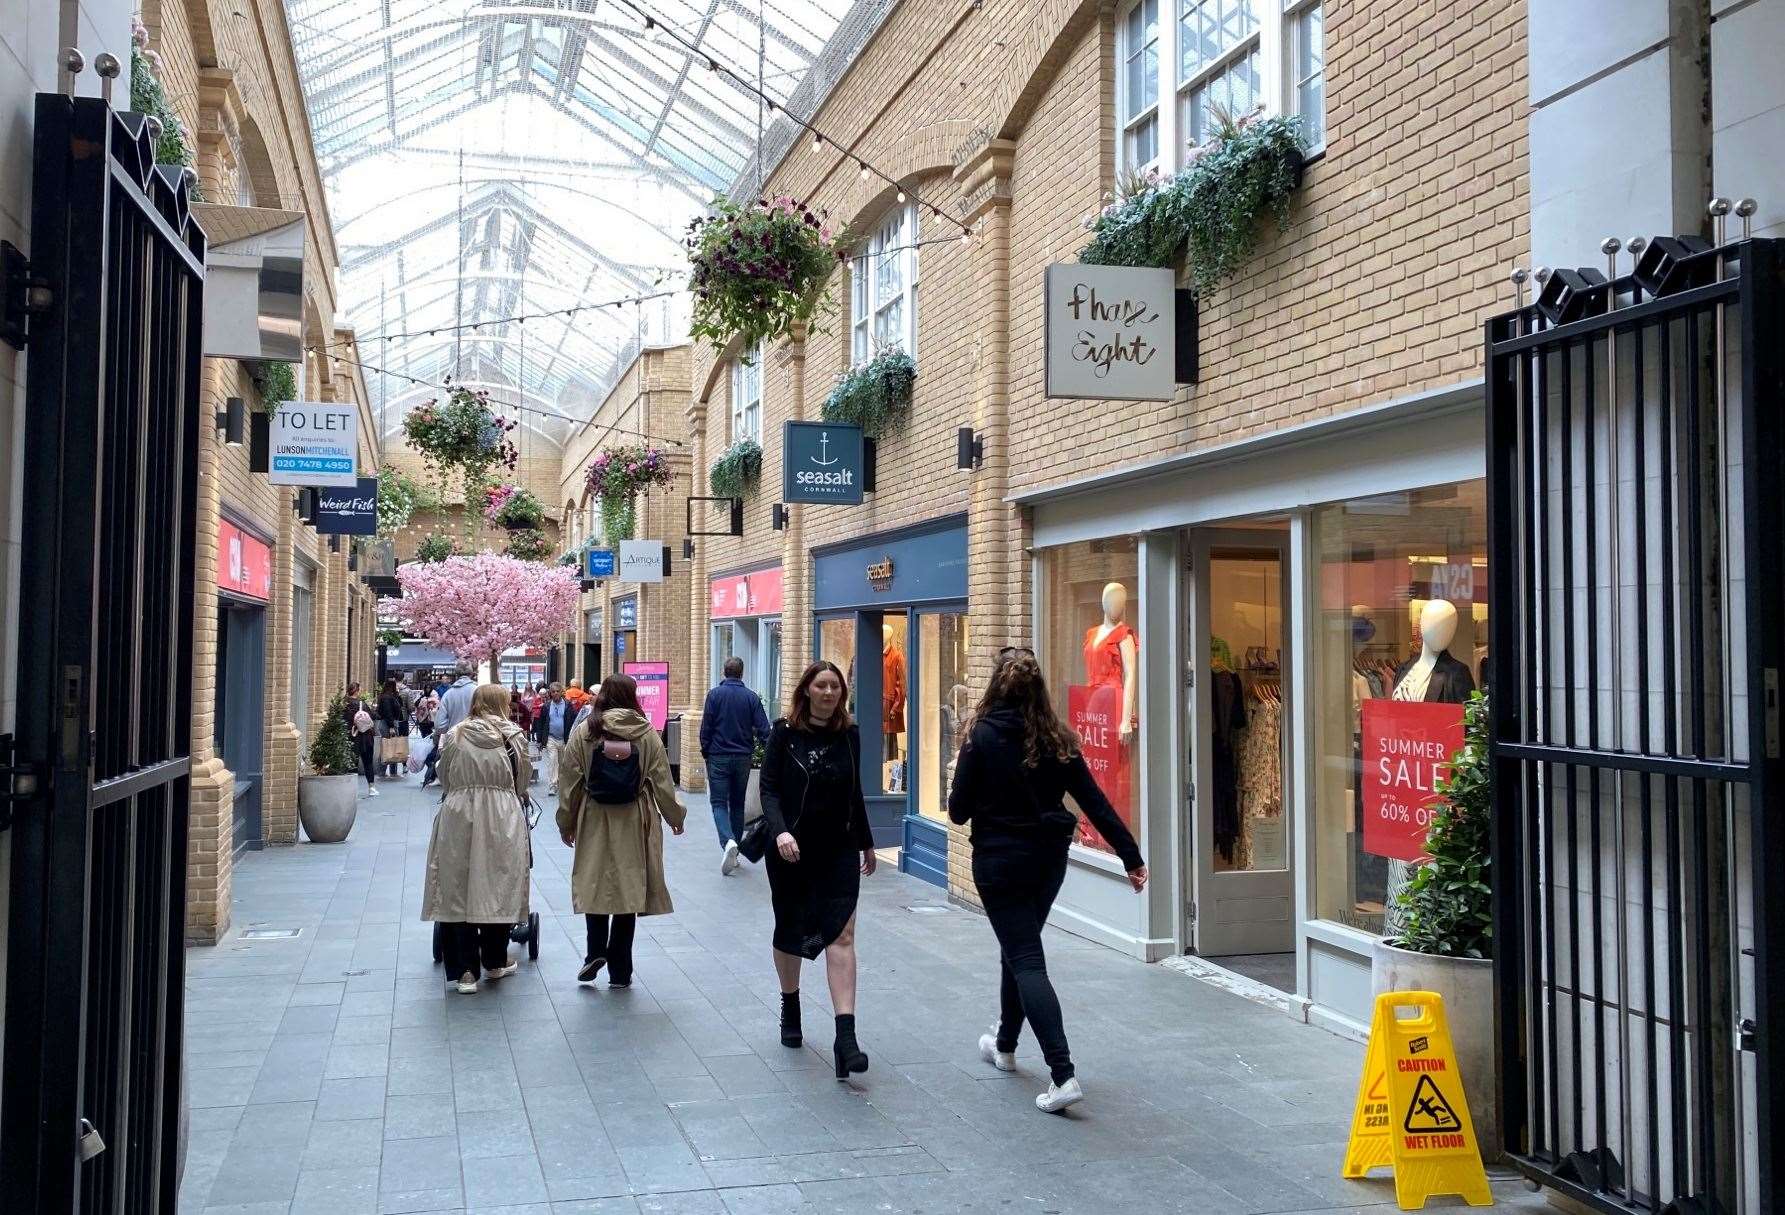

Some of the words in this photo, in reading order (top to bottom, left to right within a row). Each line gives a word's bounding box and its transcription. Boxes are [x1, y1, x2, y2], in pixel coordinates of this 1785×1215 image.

[1071, 329, 1157, 379] Eight
[277, 411, 306, 429] TO
[313, 412, 350, 431] LET
[276, 460, 295, 469] 020
[297, 460, 323, 469] 7478
[325, 461, 350, 470] 4950
[796, 467, 853, 486] seasalt
[804, 486, 846, 494] CORNWALL
[319, 497, 352, 510] Weird
[352, 497, 375, 511] Fish
[1075, 710, 1108, 725] SUMMER
[1076, 724, 1109, 749] SALE
[1379, 737, 1445, 760] SUMMER
[1094, 758, 1109, 772] OFF
[1379, 756, 1445, 793] SALE
[1380, 802, 1410, 823] 60%
[1415, 807, 1437, 827] OF
[1397, 1058, 1447, 1073] CAUTION
[1404, 1134, 1430, 1150] WET
[1430, 1133, 1466, 1149] FLOOR
